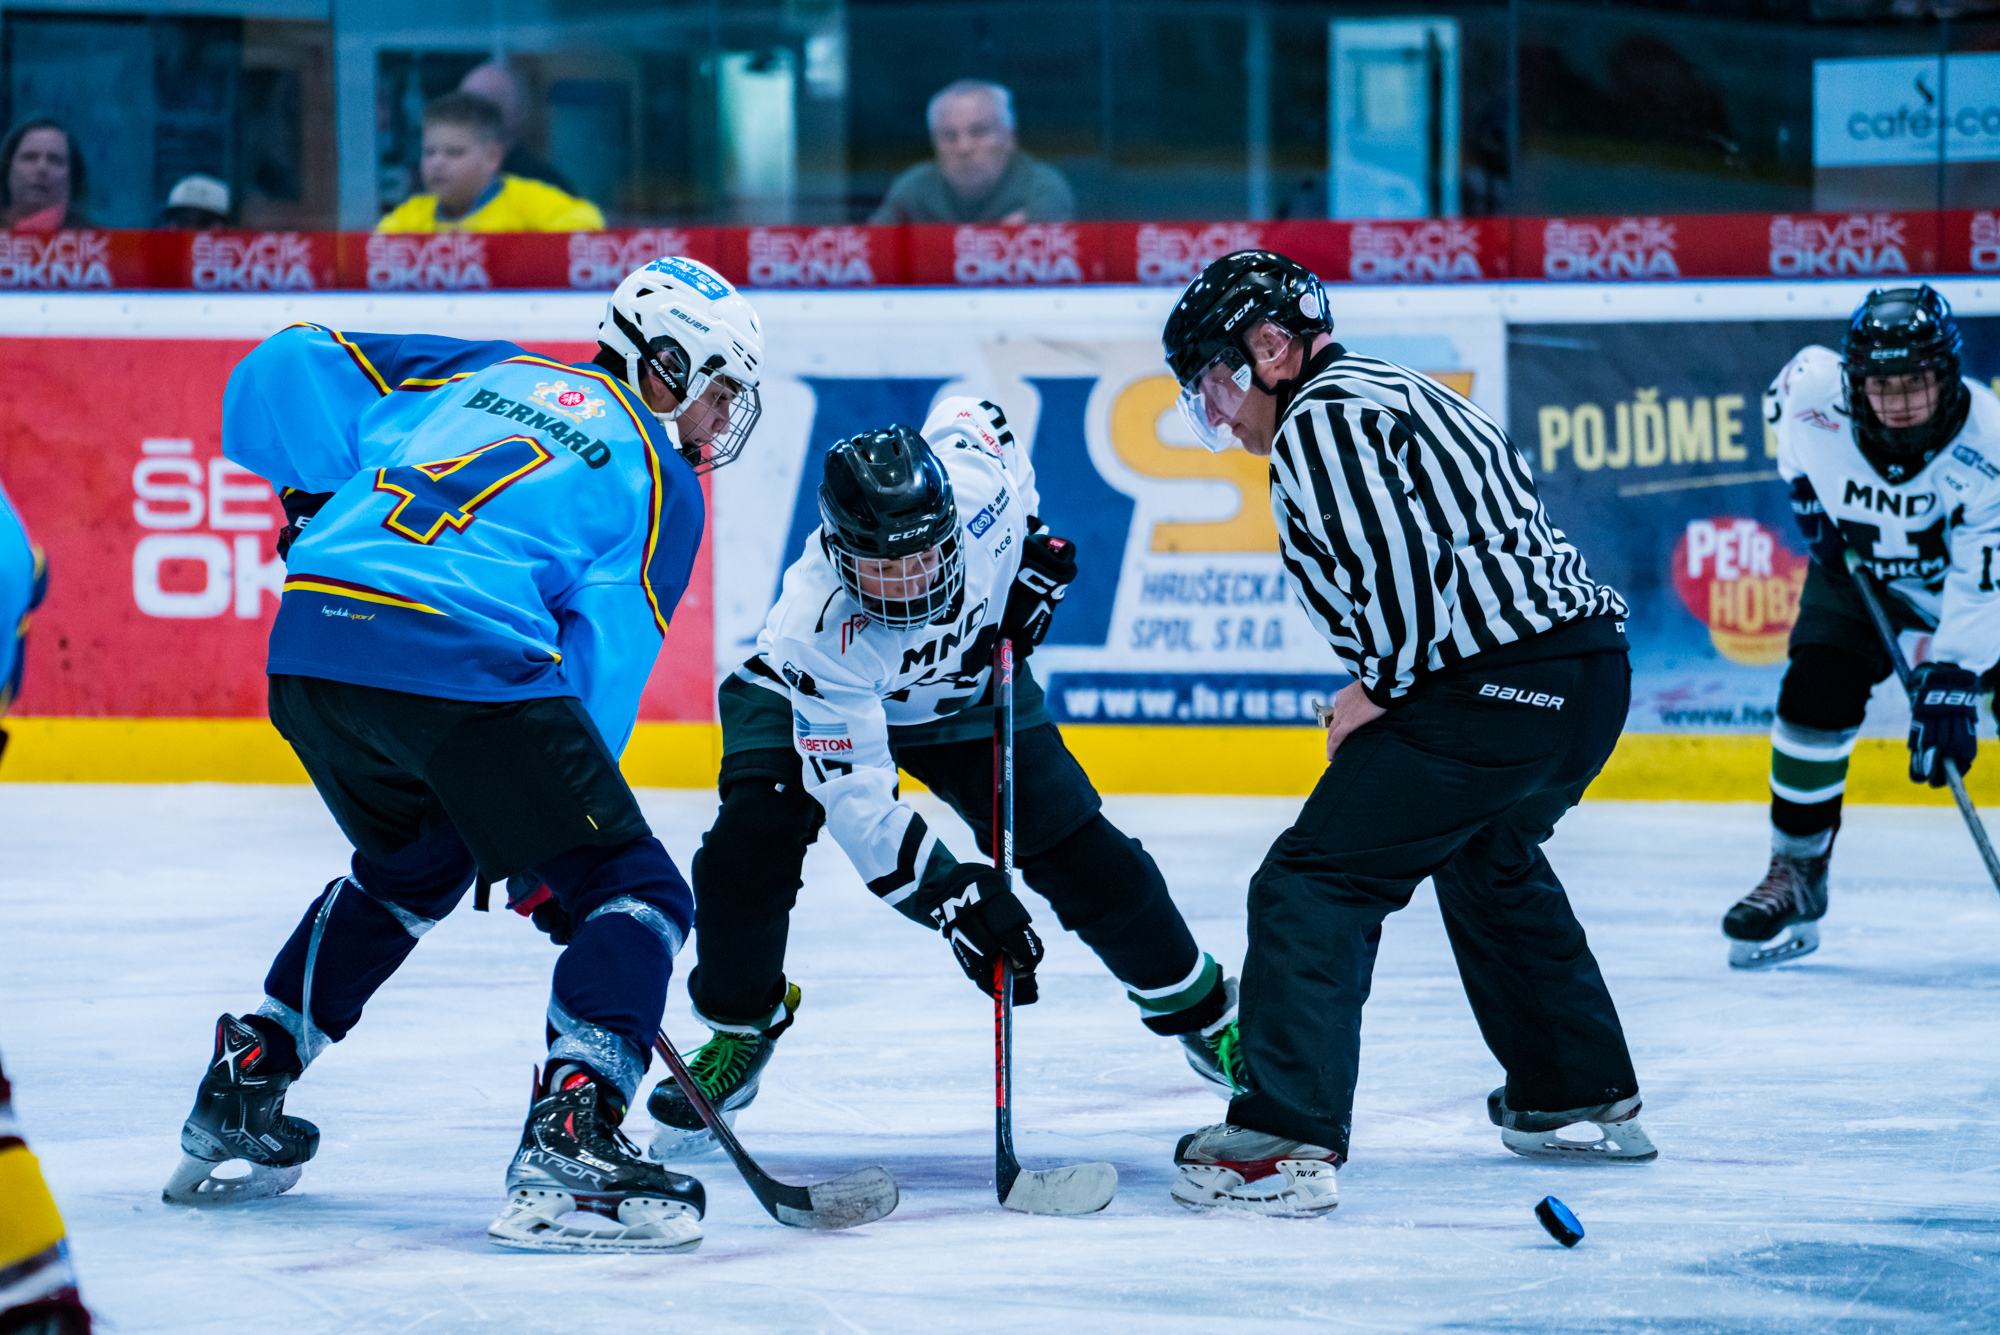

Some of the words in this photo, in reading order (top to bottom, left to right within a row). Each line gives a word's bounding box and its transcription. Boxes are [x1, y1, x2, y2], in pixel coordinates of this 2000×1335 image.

[748, 258, 876, 286] OKNA
[954, 257, 1082, 285] OKNA
[1351, 252, 1483, 282] OKNA
[1544, 250, 1680, 281] OKNA
[1770, 245, 1909, 277] OKNA
[192, 264, 314, 291] OKNA
[367, 263, 490, 291] OKNA
[669, 308, 710, 333] BAUER
[1223, 297, 1256, 332] CCM
[650, 358, 678, 390] BAUER
[461, 387, 612, 470] BERNARD
[1538, 386, 1748, 474] POJĎME
[372, 433, 556, 545] 4
[1843, 479, 1937, 519] MND
[887, 523, 930, 542] CCM
[1686, 518, 1774, 580] PETR
[899, 597, 988, 676] MND
[1478, 683, 1565, 712] BAUER
[797, 737, 853, 752] SBETON
[1004, 829, 1013, 877] BAUER
[1023, 930, 1037, 957] CCM
